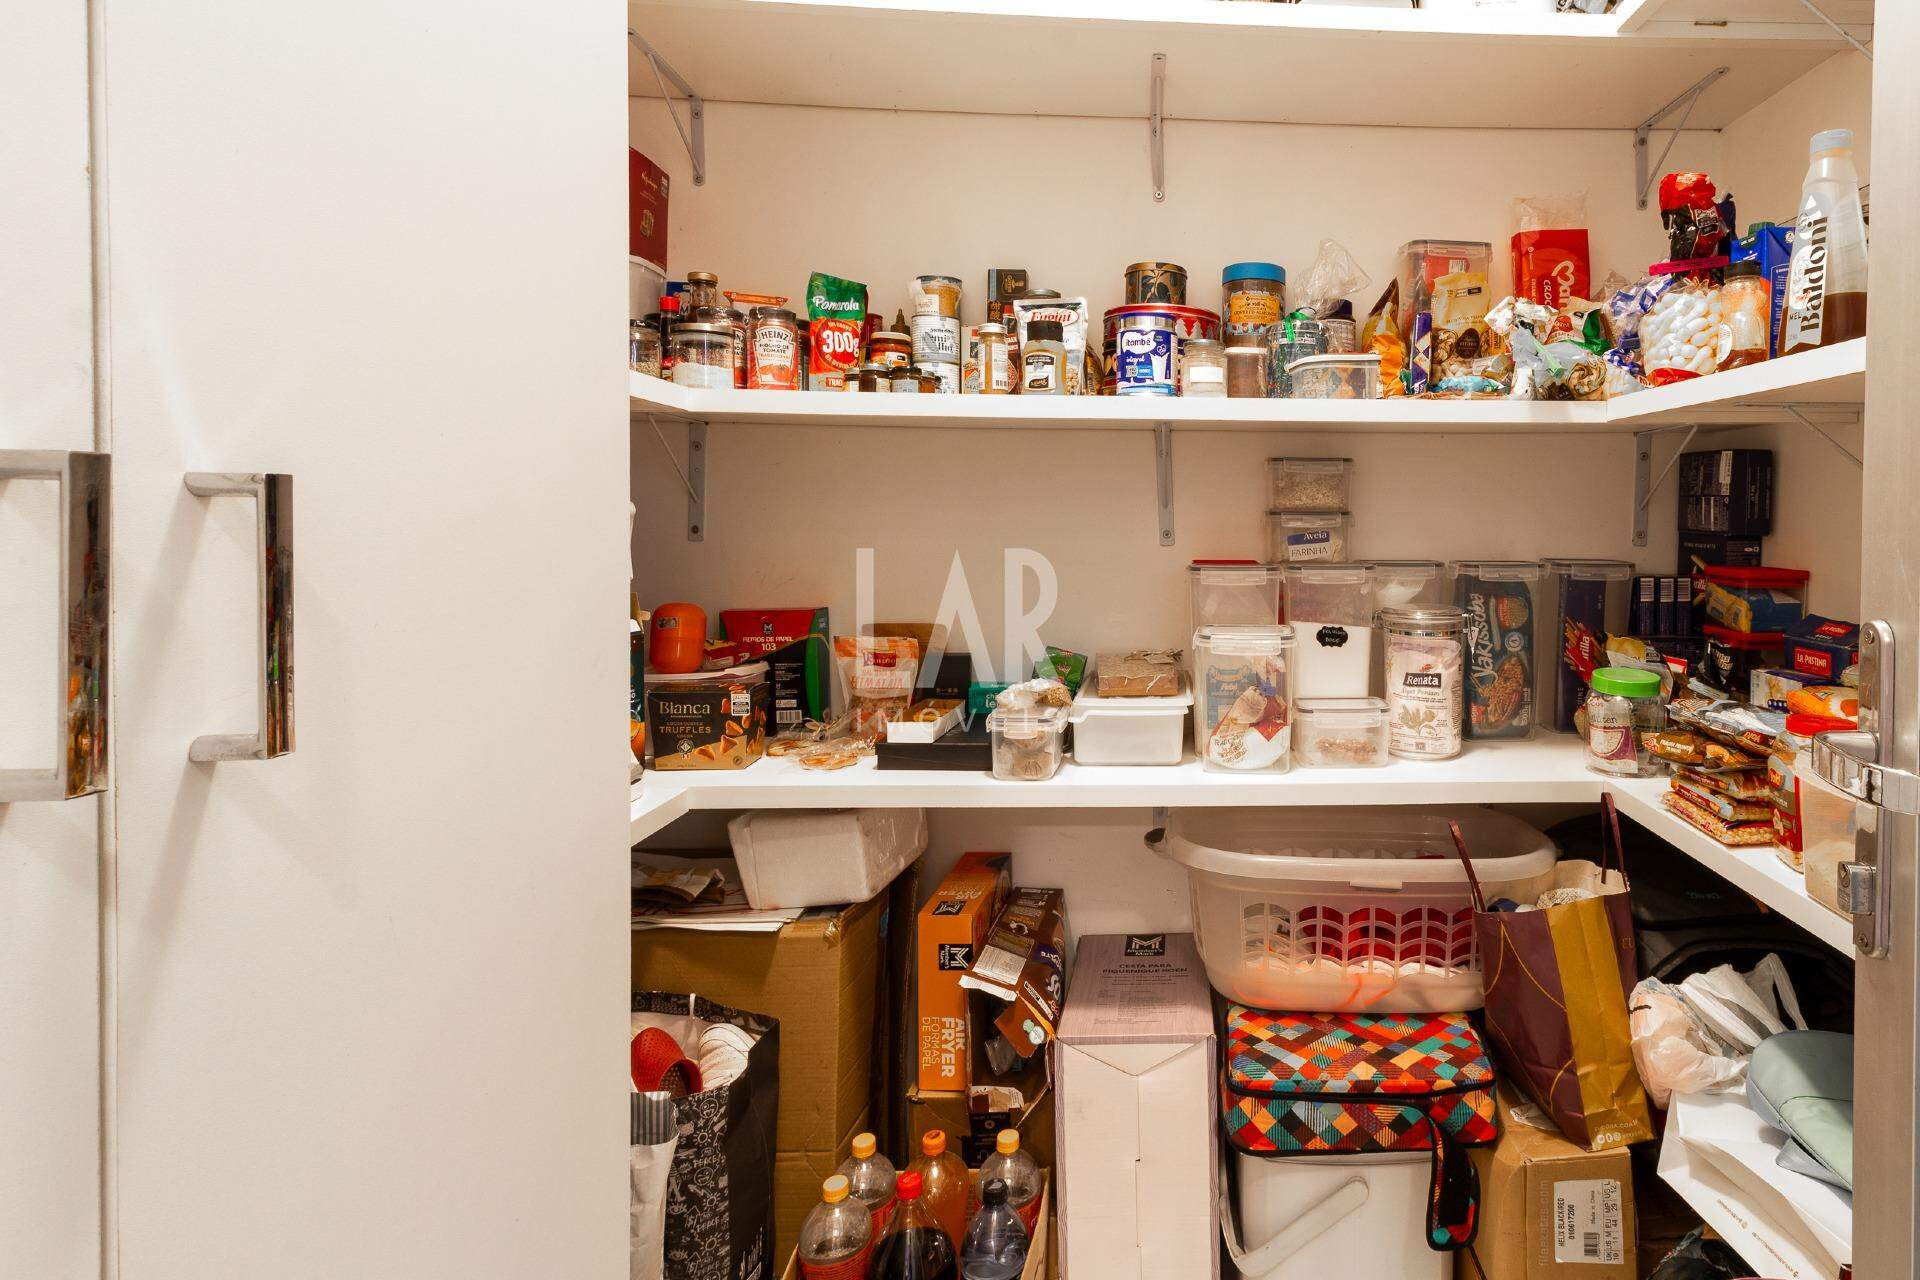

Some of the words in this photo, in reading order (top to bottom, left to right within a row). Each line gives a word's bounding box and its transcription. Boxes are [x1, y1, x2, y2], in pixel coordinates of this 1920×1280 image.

[1800, 217, 1828, 332] Baldoni
[761, 331, 789, 341] HEINZ
[822, 330, 860, 358] 300g
[1303, 530, 1328, 540] Aveia
[1291, 547, 1328, 558] FARINHA
[1471, 593, 1499, 685] Yakissoba
[1797, 653, 1804, 663] LA
[1805, 655, 1827, 668] PASTINA
[1407, 676, 1440, 686] Renata
[660, 702, 711, 714] Bianca
[922, 1017, 931, 1032] DE
[955, 1018, 965, 1050] AIR
[931, 1017, 941, 1065] FORMAS
[922, 1036, 931, 1071] PAPEL
[941, 1017, 956, 1078] FRYER
[1610, 1184, 1617, 1194] 12
[1611, 1203, 1618, 1212] 29
[1605, 1218, 1612, 1228] EU
[1612, 1219, 1619, 1228] 44
[1605, 1252, 1612, 1261] UK
